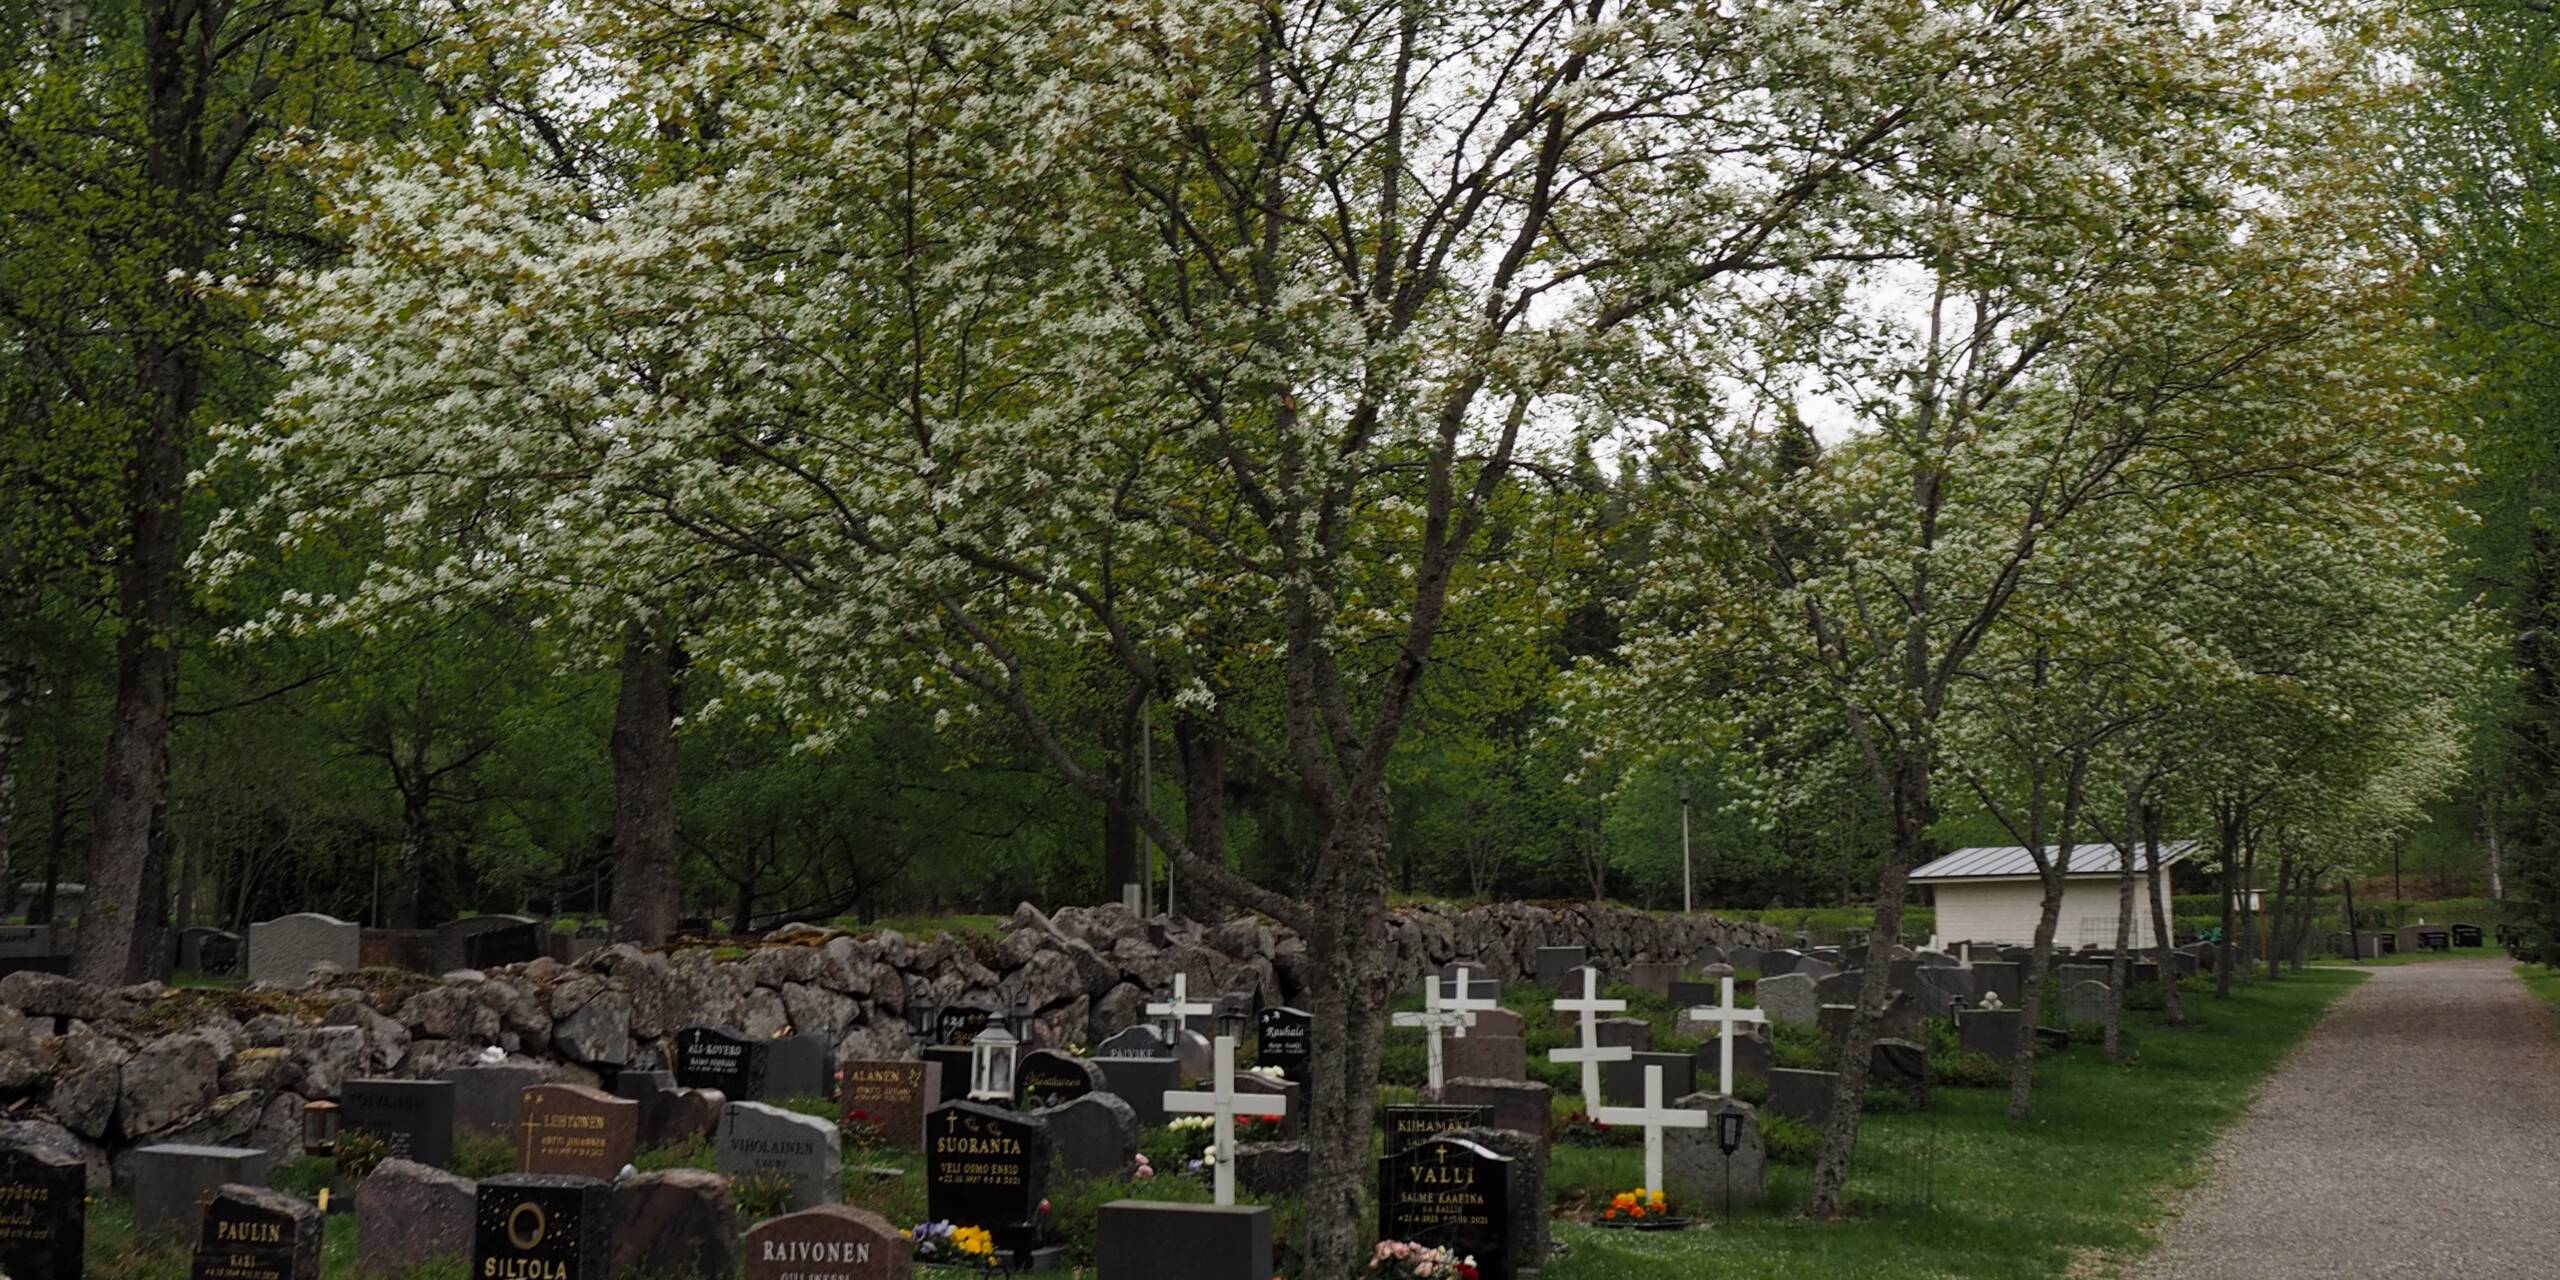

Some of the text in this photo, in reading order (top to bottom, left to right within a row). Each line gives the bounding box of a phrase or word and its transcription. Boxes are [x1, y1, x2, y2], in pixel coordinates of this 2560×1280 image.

[544, 1113, 605, 1130] LEHTONEN
[732, 1137, 814, 1156] VIHOLAINEN
[936, 1136, 1021, 1155] SUORANTA
[940, 1161, 961, 1174] VELI
[1410, 1166, 1475, 1184] VALLI
[1400, 1191, 1485, 1206] SALME KAARINA
[217, 1220, 281, 1243] PAULIN
[762, 1239, 870, 1264] RAIVONEN
[484, 1255, 568, 1280] SILTOLA
